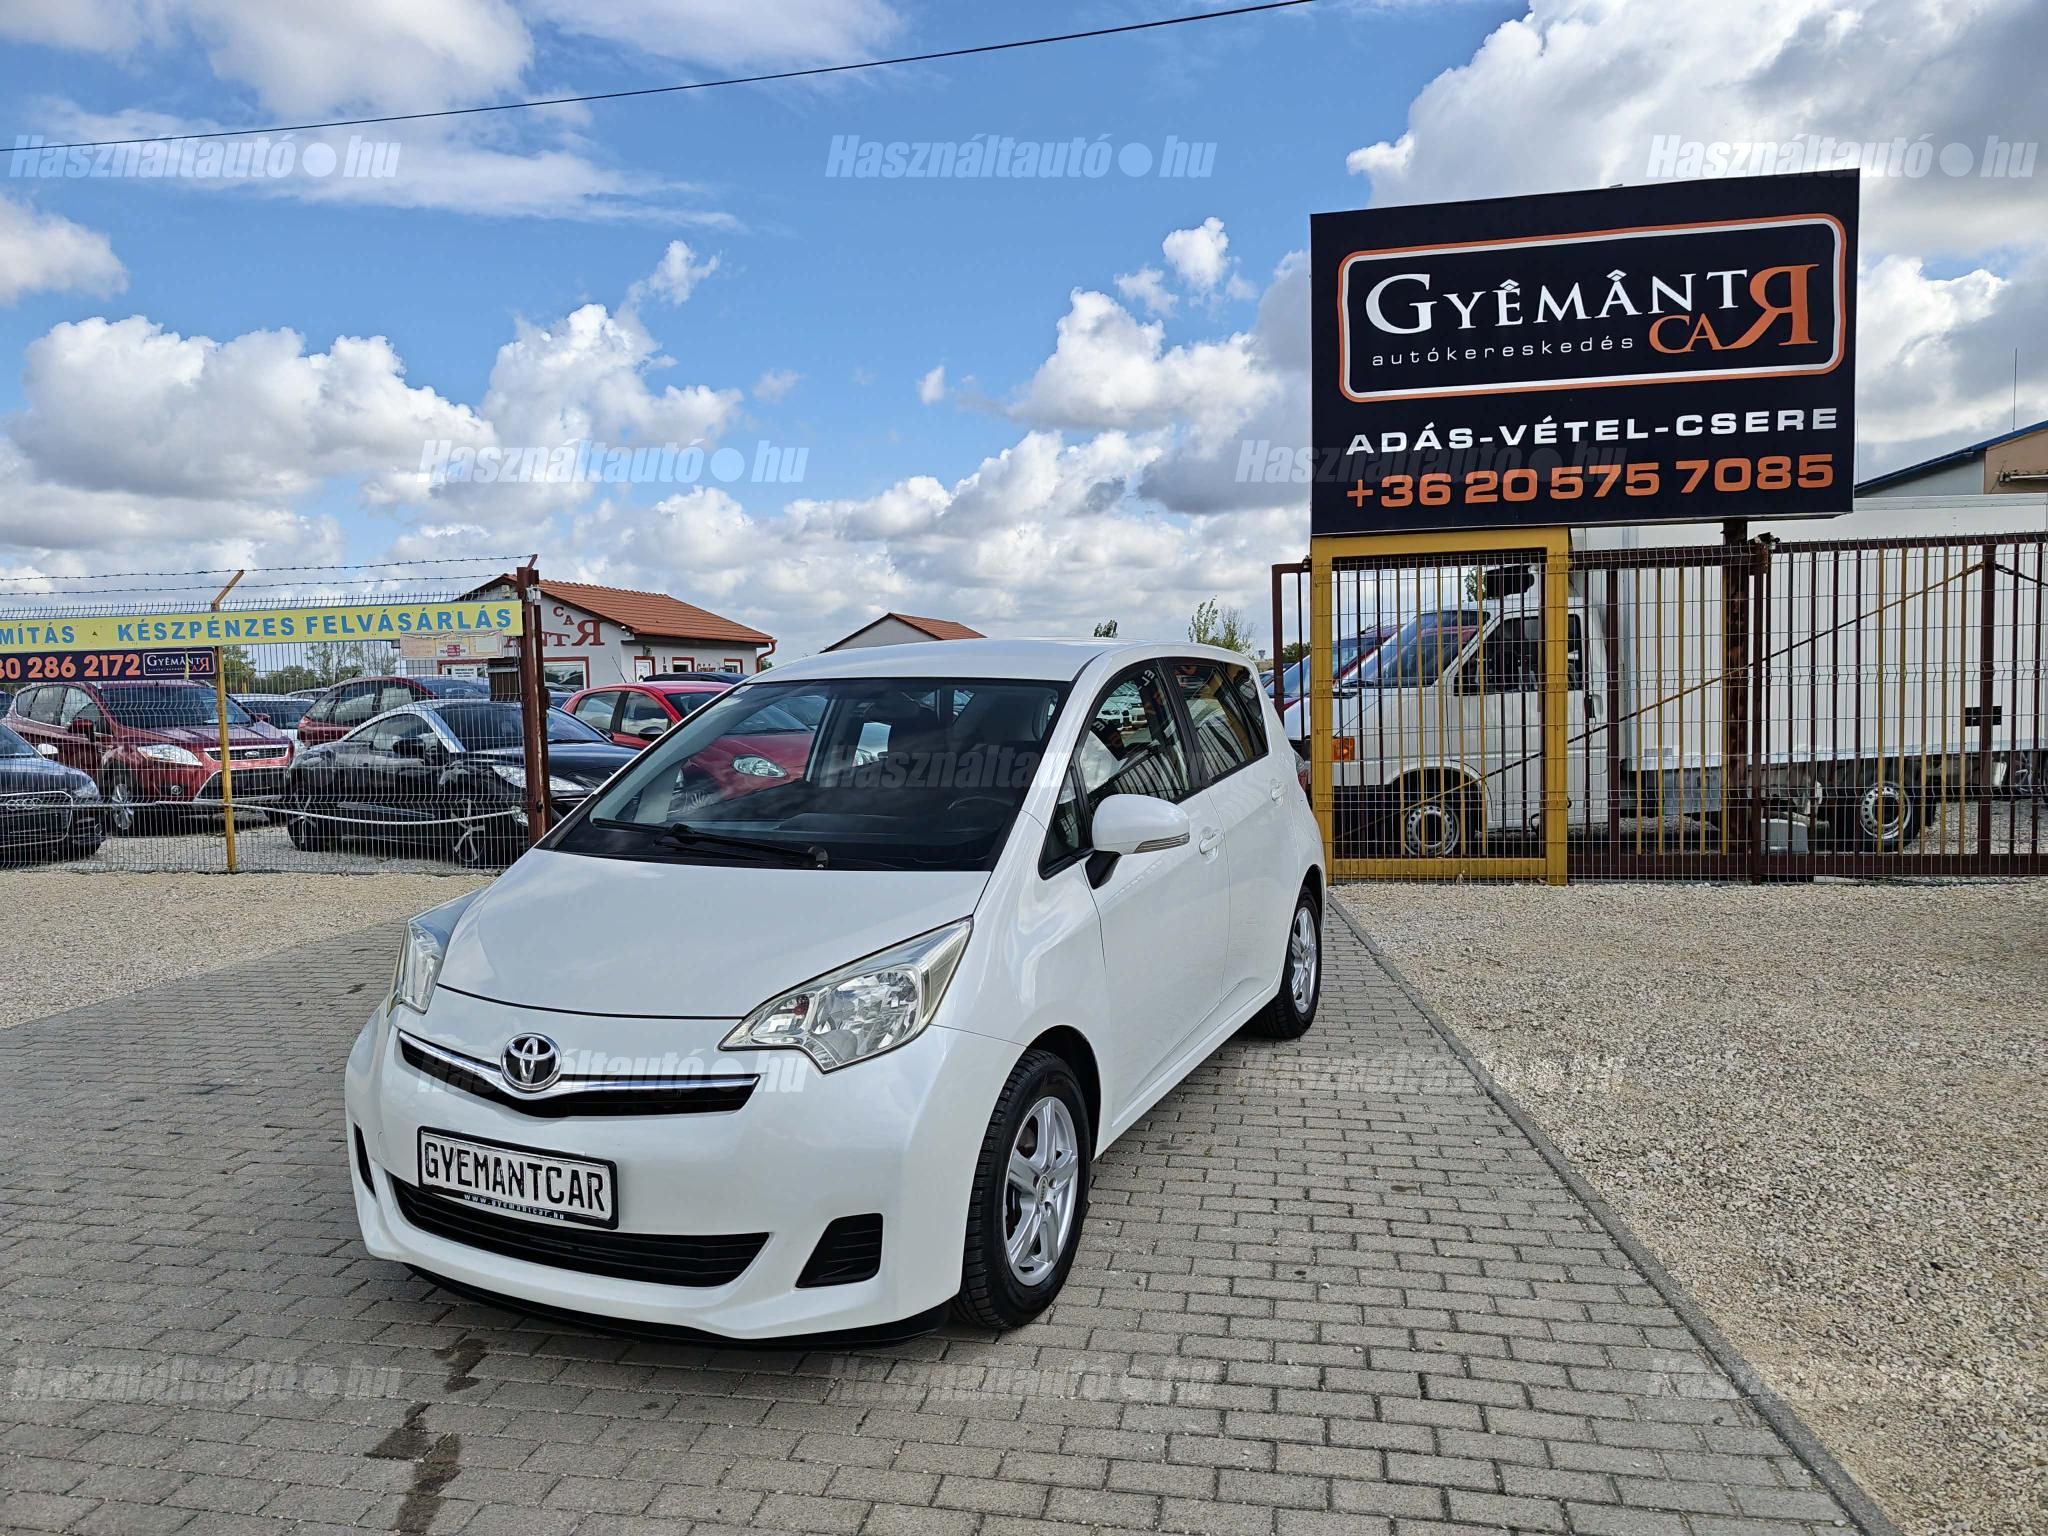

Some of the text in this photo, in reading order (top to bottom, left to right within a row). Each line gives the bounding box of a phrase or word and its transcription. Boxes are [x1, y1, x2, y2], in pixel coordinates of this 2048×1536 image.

[1372, 336, 1634, 367] autókereskedés
[1346, 407, 1838, 456] ADÁS-VÉTEL-CSERE
[1346, 453, 1834, 508] +36 20 575 7085
[117, 616, 295, 642] KÉSZPÉNZES
[305, 605, 512, 635] FELVÁSÁRLÁS
[27, 656, 76, 679] 286
[83, 653, 141, 677] 2172
[424, 1142, 605, 1212] GYEMANTCAR
[463, 1193, 565, 1220] www.gyemantcar.hu
